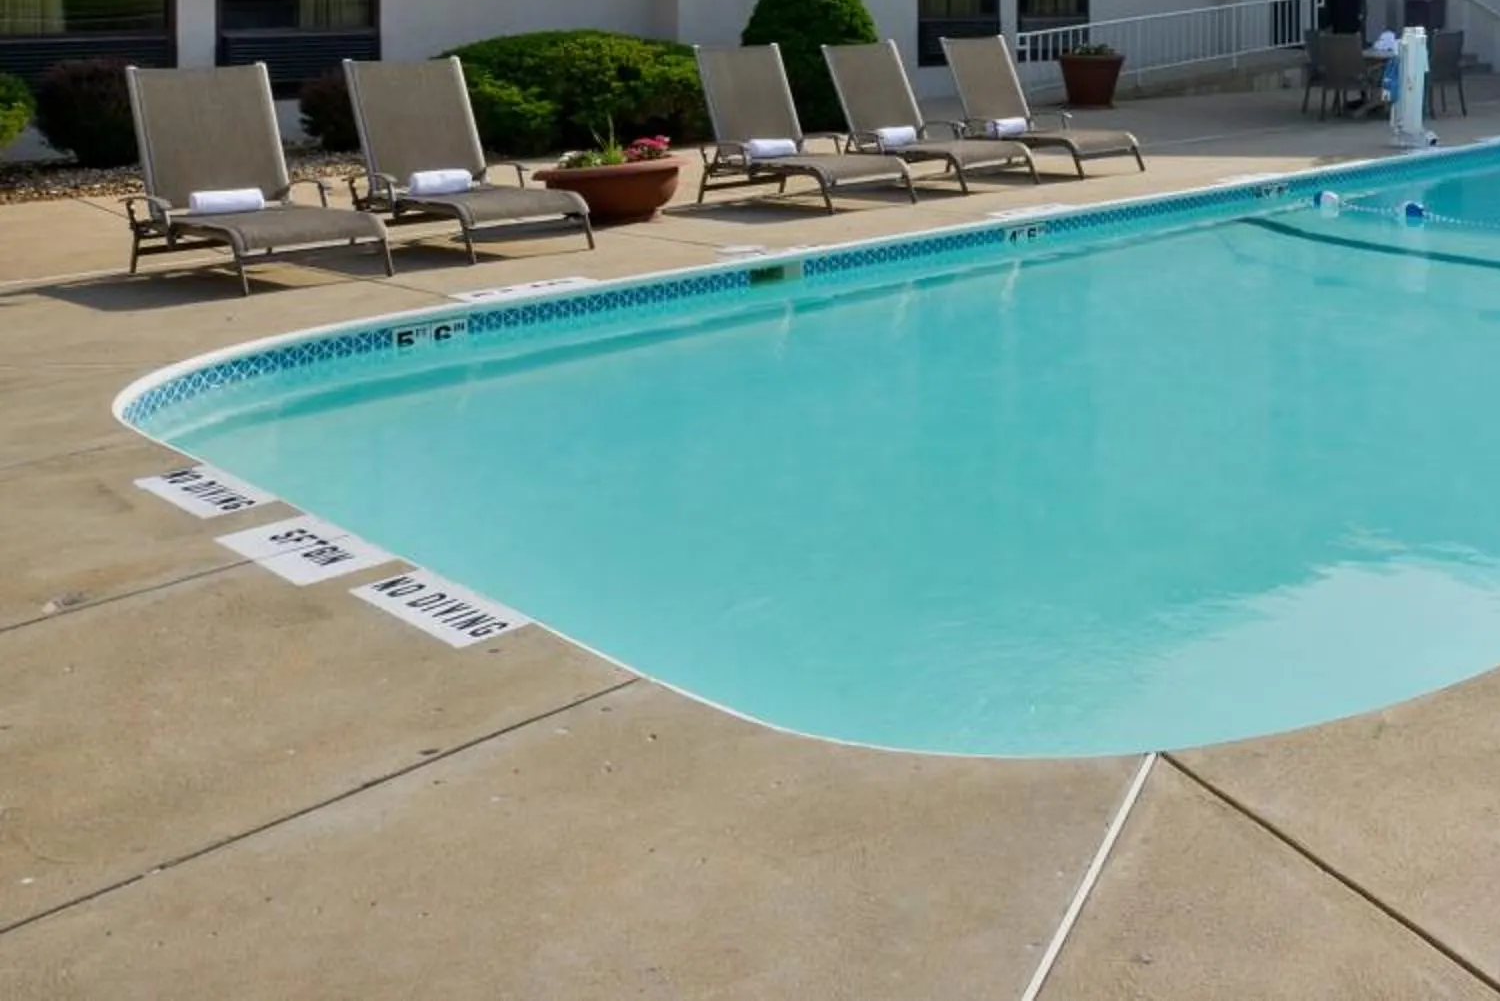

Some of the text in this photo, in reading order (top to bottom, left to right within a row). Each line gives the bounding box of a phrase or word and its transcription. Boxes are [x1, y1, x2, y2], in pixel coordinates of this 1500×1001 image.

[182, 480, 256, 510] DIVING
[371, 576, 509, 638] NO DIVING
